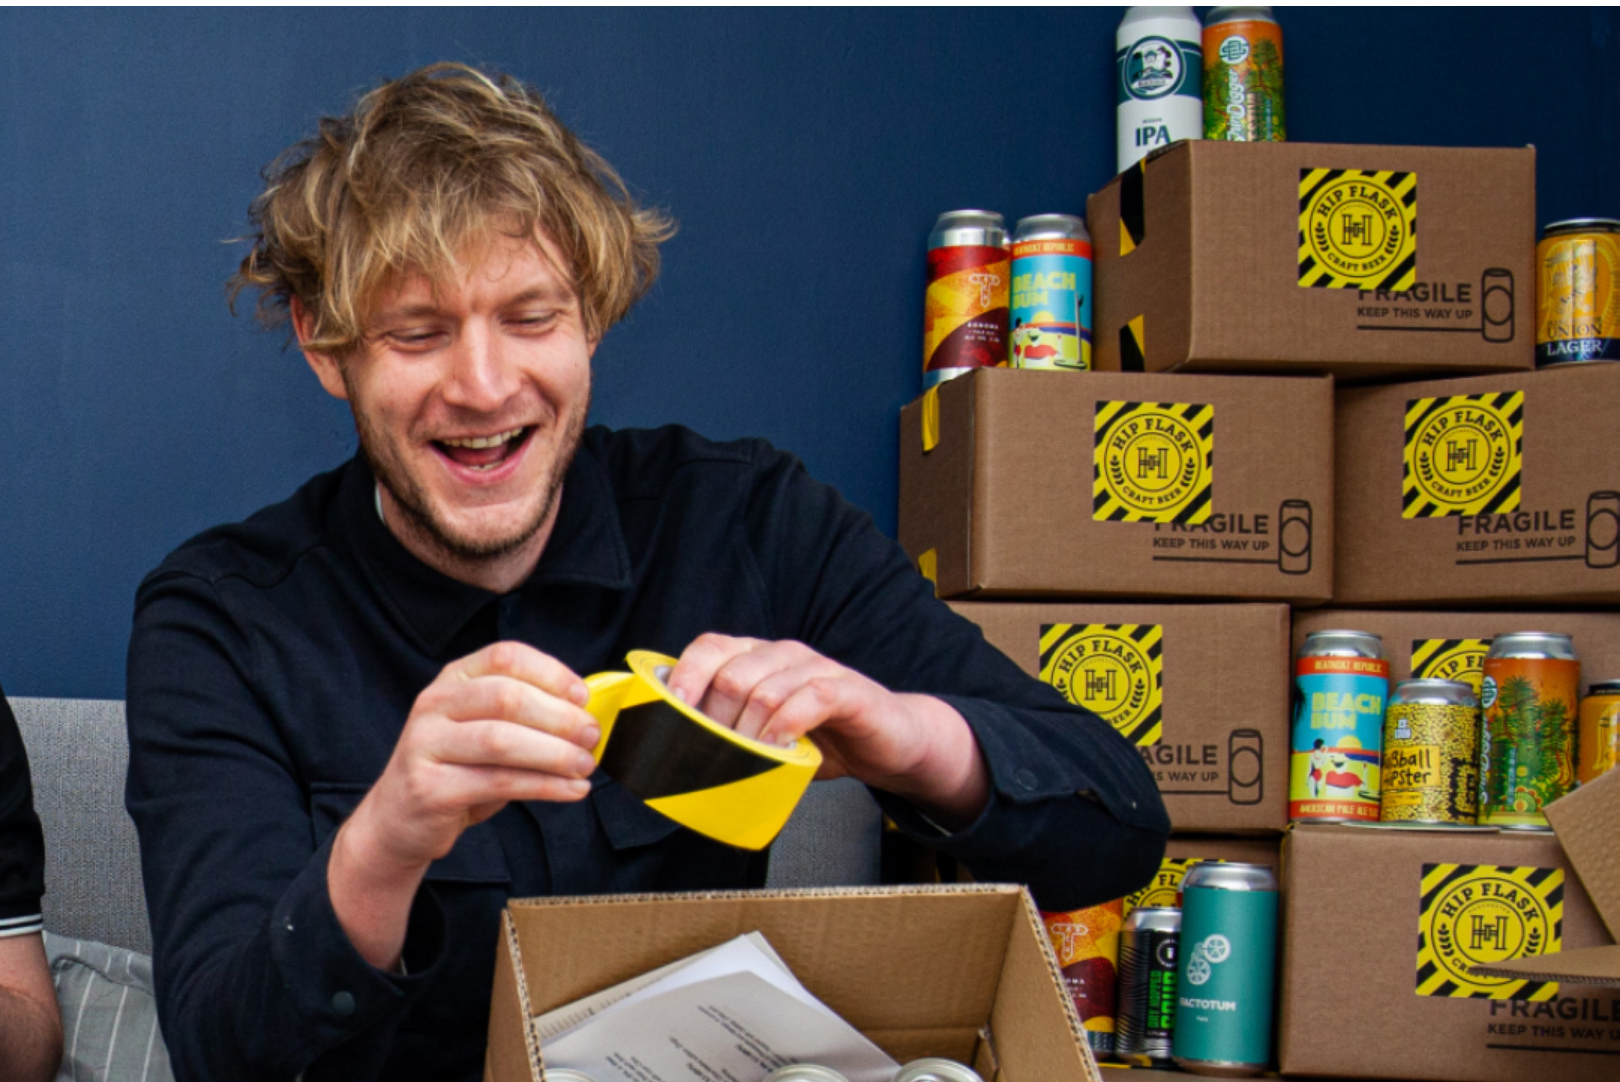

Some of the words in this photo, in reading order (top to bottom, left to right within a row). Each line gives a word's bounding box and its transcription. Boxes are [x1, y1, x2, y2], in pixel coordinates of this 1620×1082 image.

[1135, 125, 1171, 147] IPA
[1317, 189, 1344, 218] HIP
[1349, 185, 1398, 220] FLASK
[1327, 252, 1359, 272] CRAFT
[1361, 254, 1387, 272] BEER
[1013, 271, 1076, 292] BEACH
[1013, 290, 1049, 310] BUM
[1357, 307, 1389, 318] KEEP
[1393, 308, 1420, 318] THIS
[1424, 309, 1451, 319] WAY
[1455, 309, 1473, 319] UP
[1547, 339, 1603, 357] LAGER
[1112, 421, 1139, 450] HIP
[1145, 418, 1193, 452] FLASK
[1422, 416, 1449, 447] HIP
[1454, 410, 1503, 442] FLASK
[1122, 484, 1154, 505] CRAFT
[1157, 487, 1182, 505] BEER
[1431, 480, 1463, 498] CRAFT
[1466, 478, 1491, 497] BEER
[1458, 509, 1576, 535] FRAGILE
[1153, 537, 1184, 548] KEEP
[1189, 538, 1216, 549] THIS
[1220, 539, 1249, 550] WAY
[1253, 540, 1270, 551] UP
[1456, 540, 1489, 552] KEEP
[1493, 538, 1521, 550] THIS
[1524, 537, 1555, 549] WAY
[1557, 536, 1576, 547] UP
[1058, 644, 1085, 674] HIP
[1091, 639, 1143, 674] FLASK
[1435, 659, 1459, 681] IP
[1311, 692, 1381, 715] BEACH
[1310, 711, 1357, 730] BUM
[1139, 744, 1218, 766] AGILE
[1384, 747, 1432, 770] ßball
[1168, 772, 1198, 782] WAY
[1201, 772, 1219, 783] UP
[1441, 888, 1473, 918] HIP
[1481, 883, 1539, 922] FLASK
[1487, 1023, 1527, 1035] KEEP
[1531, 1025, 1565, 1038] THIS
[1570, 1027, 1605, 1040] WAY
[1610, 1029, 1620, 1041] U
